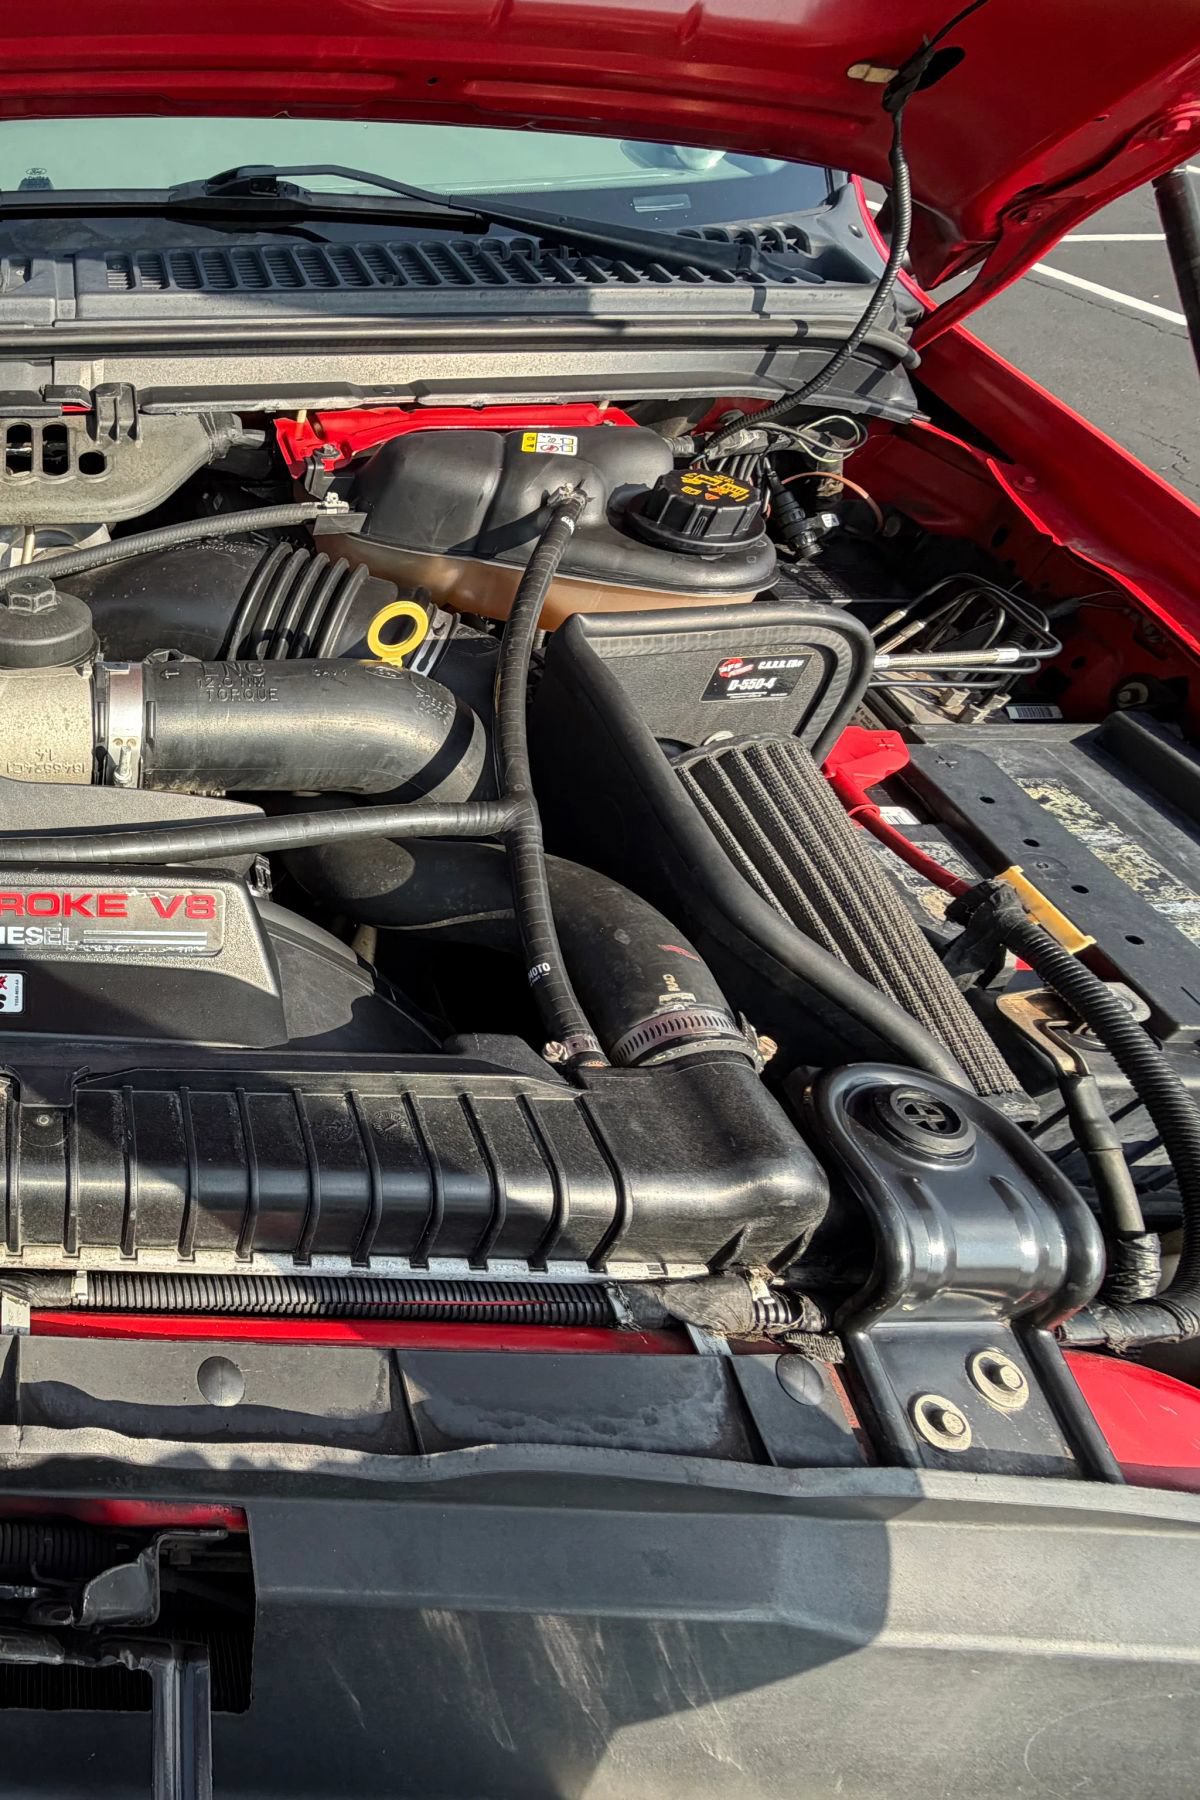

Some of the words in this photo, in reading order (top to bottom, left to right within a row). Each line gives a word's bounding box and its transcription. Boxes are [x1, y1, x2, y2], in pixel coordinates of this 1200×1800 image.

[200, 662, 266, 677] ENG
[206, 688, 279, 703] TORQUE
[149, 894, 216, 920] V8
